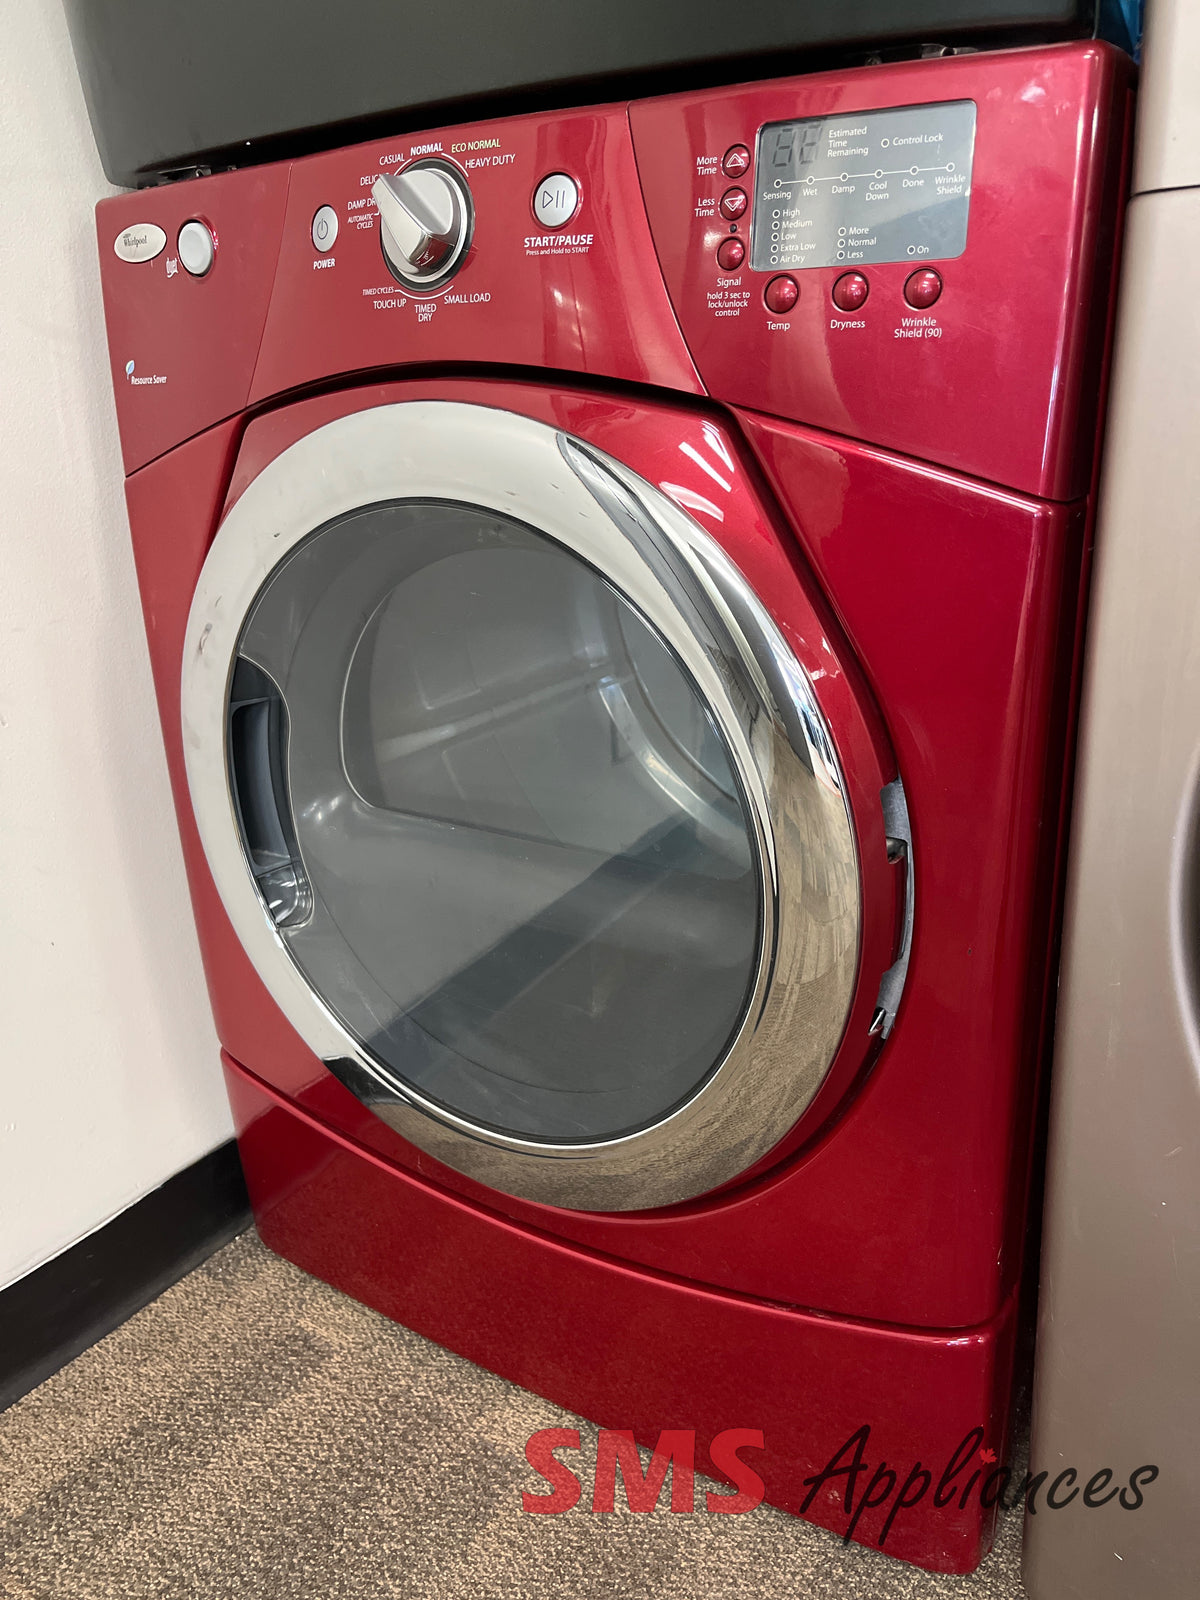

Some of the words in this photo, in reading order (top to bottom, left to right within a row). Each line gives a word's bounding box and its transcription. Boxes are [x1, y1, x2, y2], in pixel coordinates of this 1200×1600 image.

[828, 126, 868, 138] Estimated
[829, 140, 848, 148] Time
[892, 135, 922, 146] Control
[924, 133, 944, 142] Lock
[410, 142, 443, 156] NORMAL
[451, 143, 466, 154] ECO
[468, 139, 500, 151] NORMAL
[828, 147, 869, 157] Remaining
[380, 153, 405, 166] CASUAL
[465, 156, 491, 169] HEAVY
[492, 154, 516, 166] DUTY
[697, 156, 718, 166] More
[697, 166, 717, 176] Time
[902, 178, 924, 188] Done
[934, 174, 966, 184] Wrinkle
[832, 185, 856, 194] Damp
[869, 181, 888, 190] Cool
[936, 186, 962, 195] Shield
[763, 190, 792, 200] Sensing
[803, 188, 818, 196] Wet
[866, 192, 889, 200] Down
[348, 199, 366, 210] DAMP
[367, 198, 378, 207] DR
[698, 198, 715, 206] Less
[694, 208, 714, 217] Time
[782, 208, 800, 218] High
[348, 213, 373, 224] AUTOMATIC
[356, 220, 374, 230] CYCLES
[782, 220, 812, 229] Medium
[849, 226, 869, 234] More
[524, 234, 594, 248] START/PAUSE
[781, 232, 796, 240] Low
[124, 235, 147, 248] Whirlpool
[848, 238, 876, 246] Normal
[780, 244, 798, 252] Extra
[917, 246, 930, 254] On
[792, 254, 806, 263] Dry
[314, 258, 336, 270] POWER
[716, 277, 742, 288] Signal
[378, 286, 394, 294] CYCLES
[444, 294, 468, 304] SMALL
[470, 292, 490, 303] LOAD
[373, 300, 396, 310] TOUCH
[397, 298, 406, 308] UP
[414, 304, 436, 313] TIMED
[708, 299, 748, 308] lock/unlock
[715, 308, 740, 316] control
[418, 313, 432, 322] DRY
[902, 317, 936, 327] Wrinkle
[766, 322, 790, 331] Temp
[830, 320, 866, 330] Dryness
[894, 328, 922, 338] Shield
[924, 328, 942, 338] (90)
[131, 376, 152, 384] Resource
[153, 374, 167, 384] Saver
